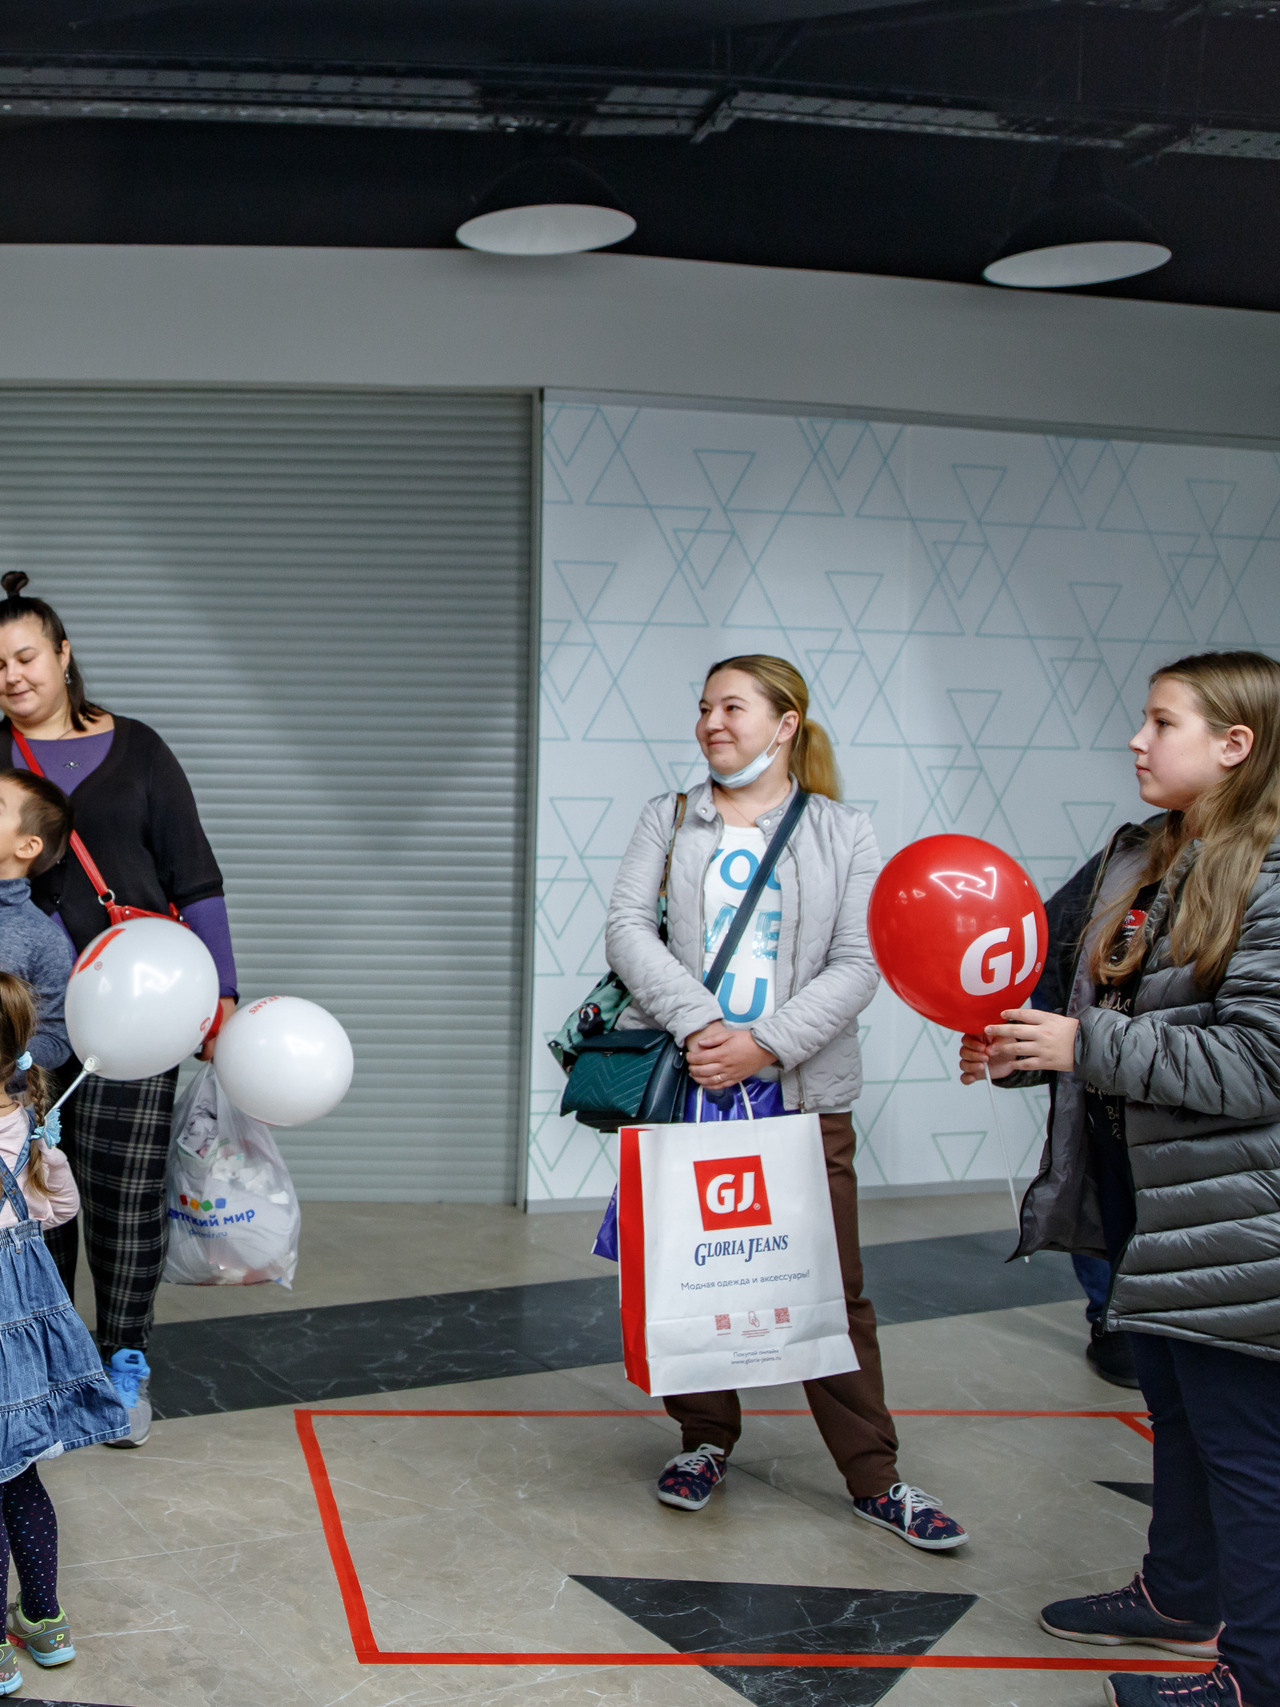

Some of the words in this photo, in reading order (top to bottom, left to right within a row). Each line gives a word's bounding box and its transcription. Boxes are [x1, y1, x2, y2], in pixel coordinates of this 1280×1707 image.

[960, 911, 1038, 996] GJ
[706, 1171, 755, 1214] GJ
[223, 1209, 255, 1223] мир
[694, 1240, 745, 1266] GLORIA
[744, 1234, 789, 1262] JEANS
[680, 1282, 715, 1291] Модная
[716, 1278, 750, 1288] одежда
[760, 1269, 810, 1283] аксессуары!
